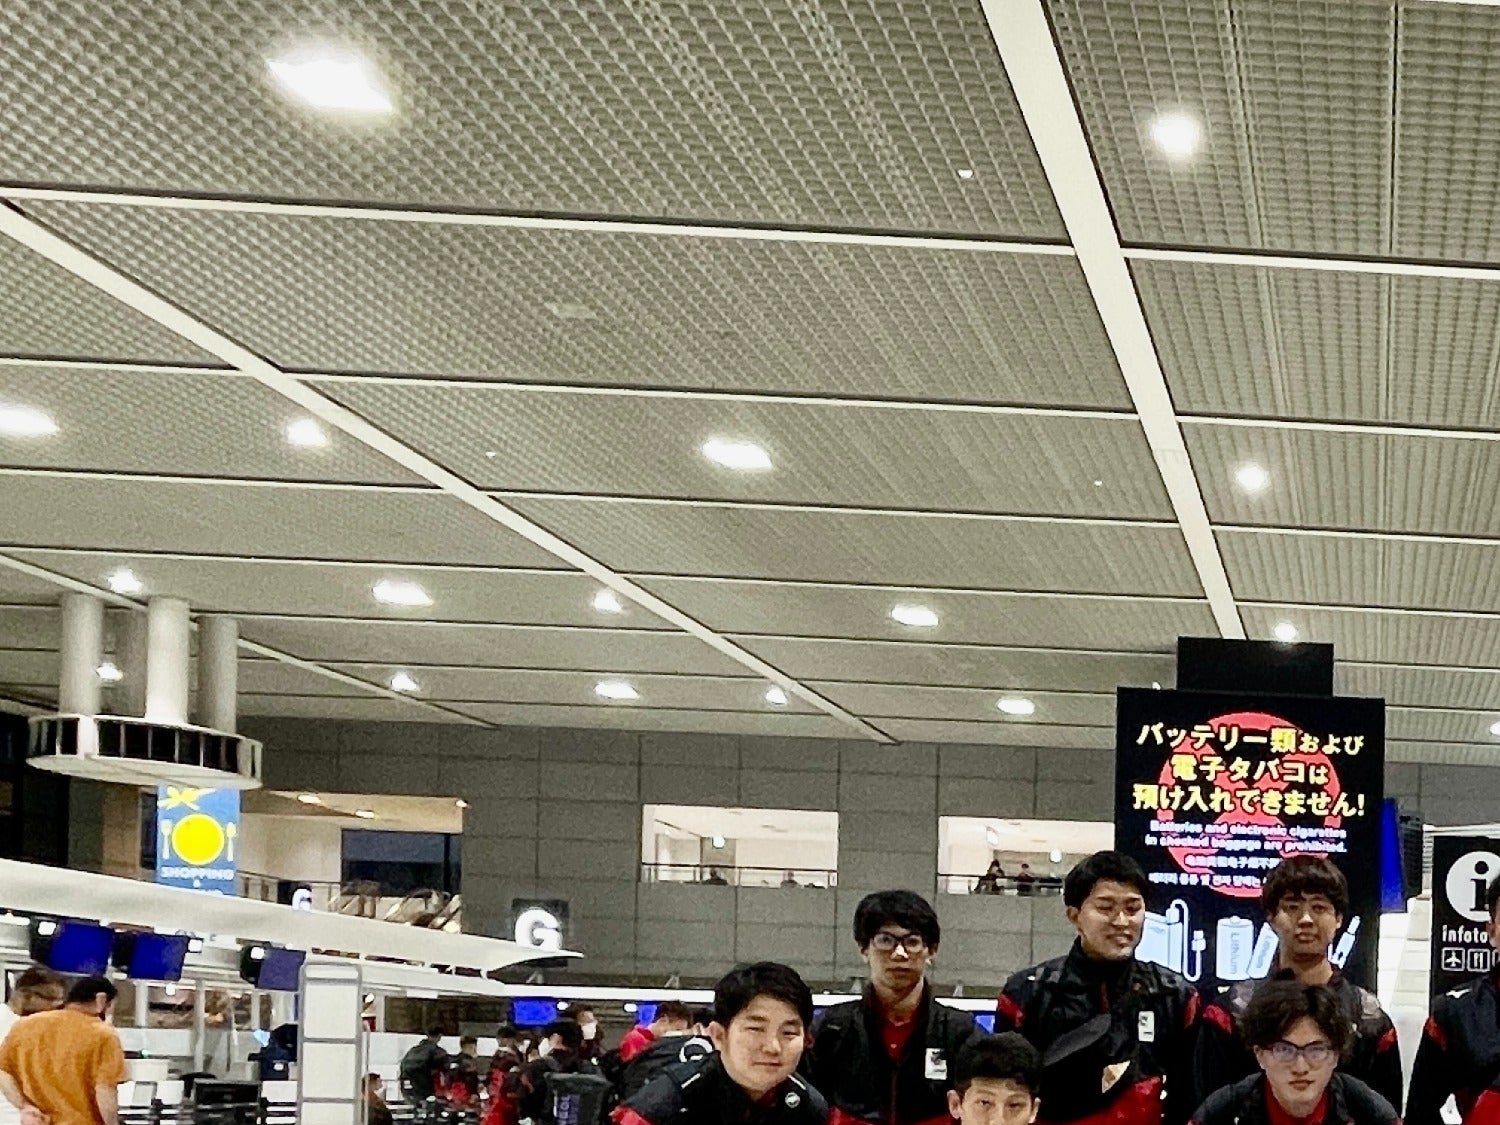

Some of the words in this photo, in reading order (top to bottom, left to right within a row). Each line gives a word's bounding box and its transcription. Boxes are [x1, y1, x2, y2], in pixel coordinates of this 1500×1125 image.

[1136, 721, 1364, 756] バッテリー類および
[1169, 754, 1329, 786] 電子タバコは
[1132, 783, 1365, 817] 預け入れできません!
[1205, 821, 1228, 835] and
[1230, 823, 1287, 837] electronic
[1289, 825, 1347, 840] cigarettes
[1211, 837, 1261, 851] baggage
[515, 906, 563, 953] G
[1442, 924, 1489, 944] infoto
